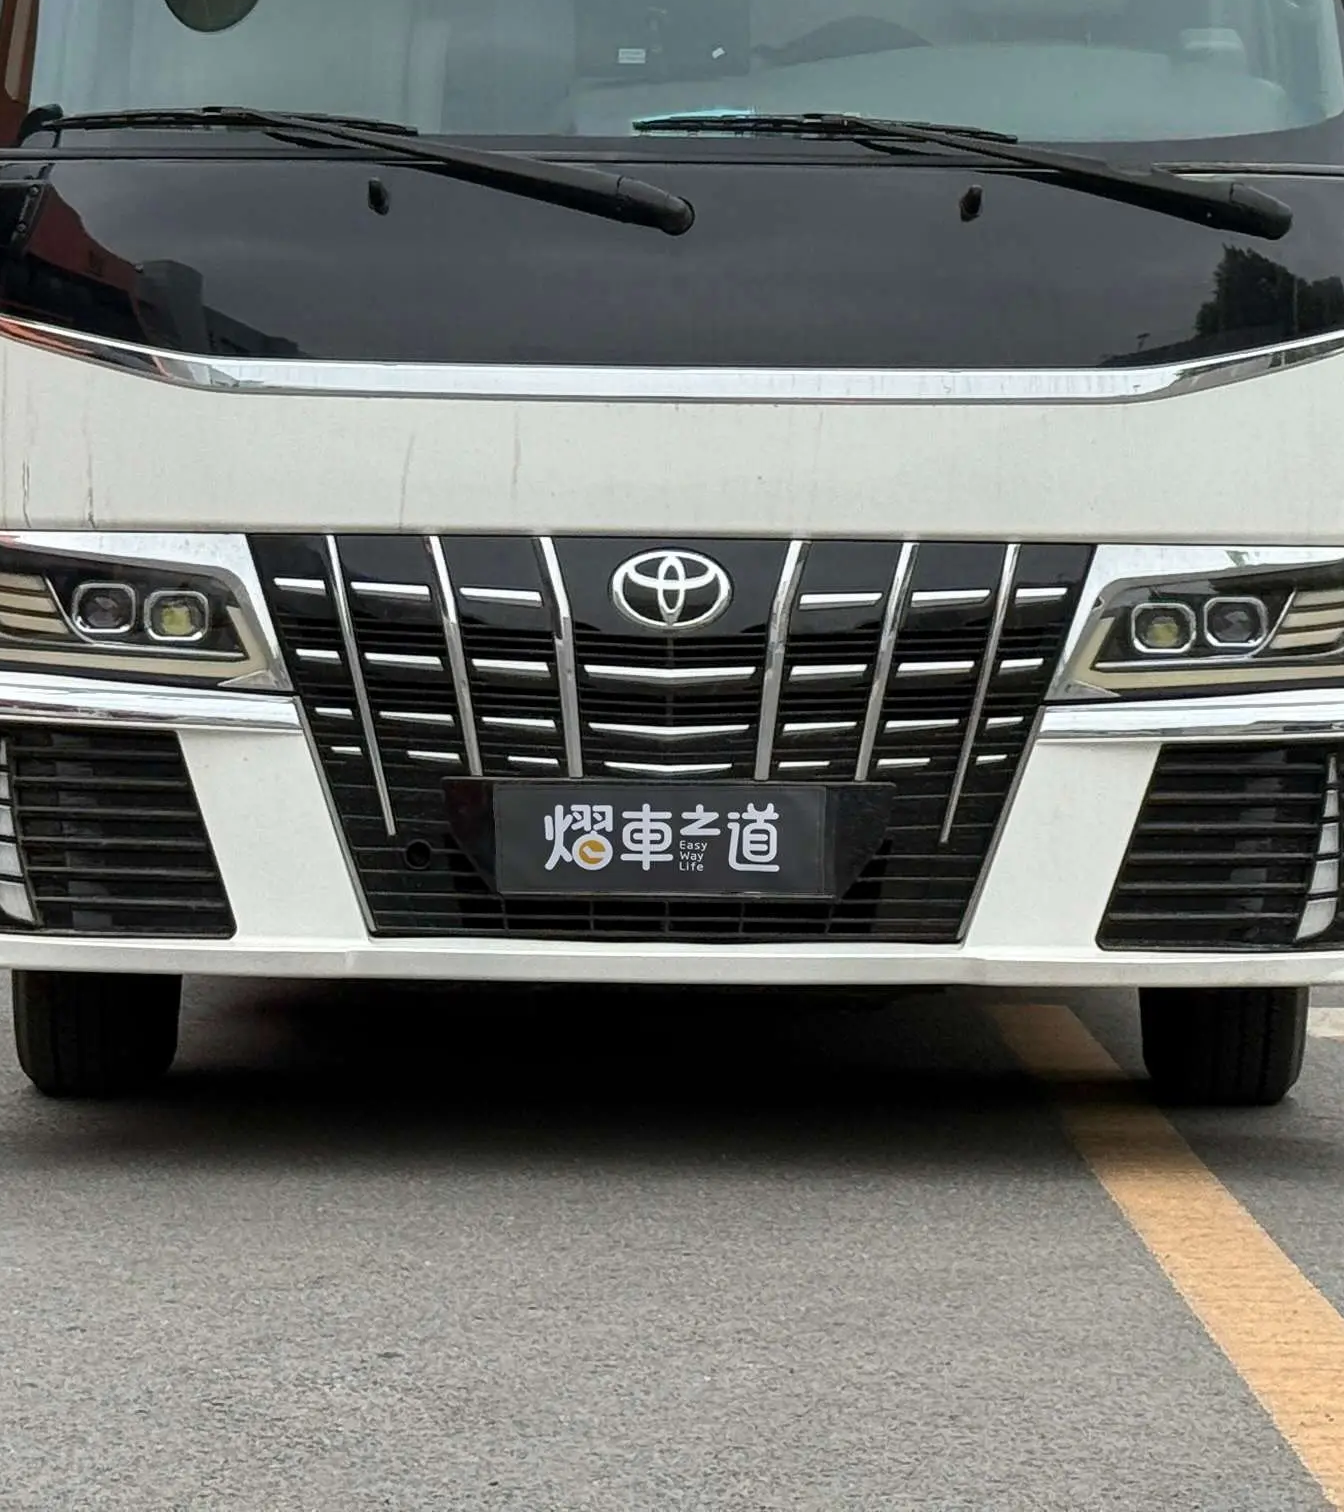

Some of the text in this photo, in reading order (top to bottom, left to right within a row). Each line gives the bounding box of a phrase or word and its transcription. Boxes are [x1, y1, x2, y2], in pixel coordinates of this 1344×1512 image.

[679, 840, 708, 852] Easy
[679, 850, 705, 862] Way
[679, 861, 705, 872] Life
